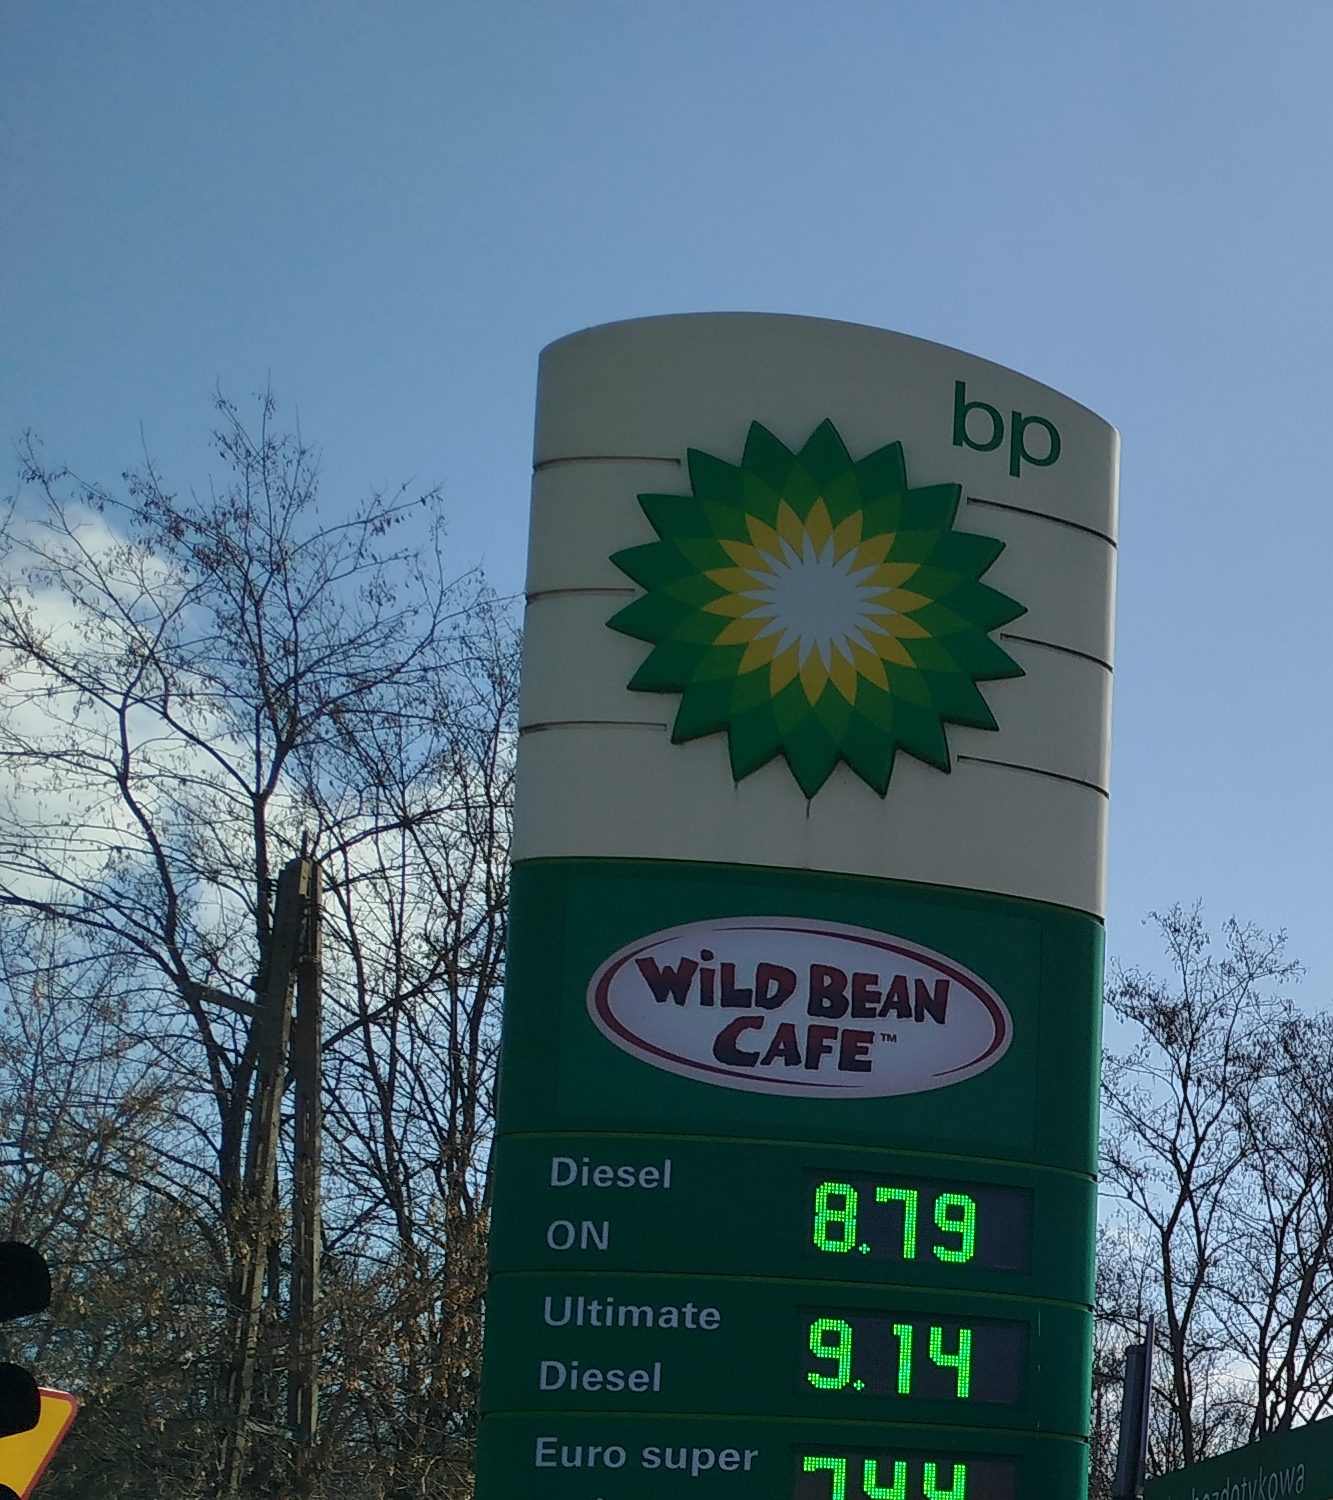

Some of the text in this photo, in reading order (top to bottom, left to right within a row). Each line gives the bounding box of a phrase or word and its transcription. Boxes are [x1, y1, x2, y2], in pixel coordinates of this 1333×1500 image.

[952, 380, 1061, 478] bp
[807, 963, 950, 1025] BEAN
[550, 1156, 673, 1189] Diesel
[546, 1220, 610, 1251] ON
[812, 1182, 977, 1263] 8.79
[543, 1297, 721, 1331] Ultimate
[538, 1360, 662, 1392] Diesel
[807, 1318, 972, 1399] 9.14
[534, 1436, 759, 1475] Euro super
